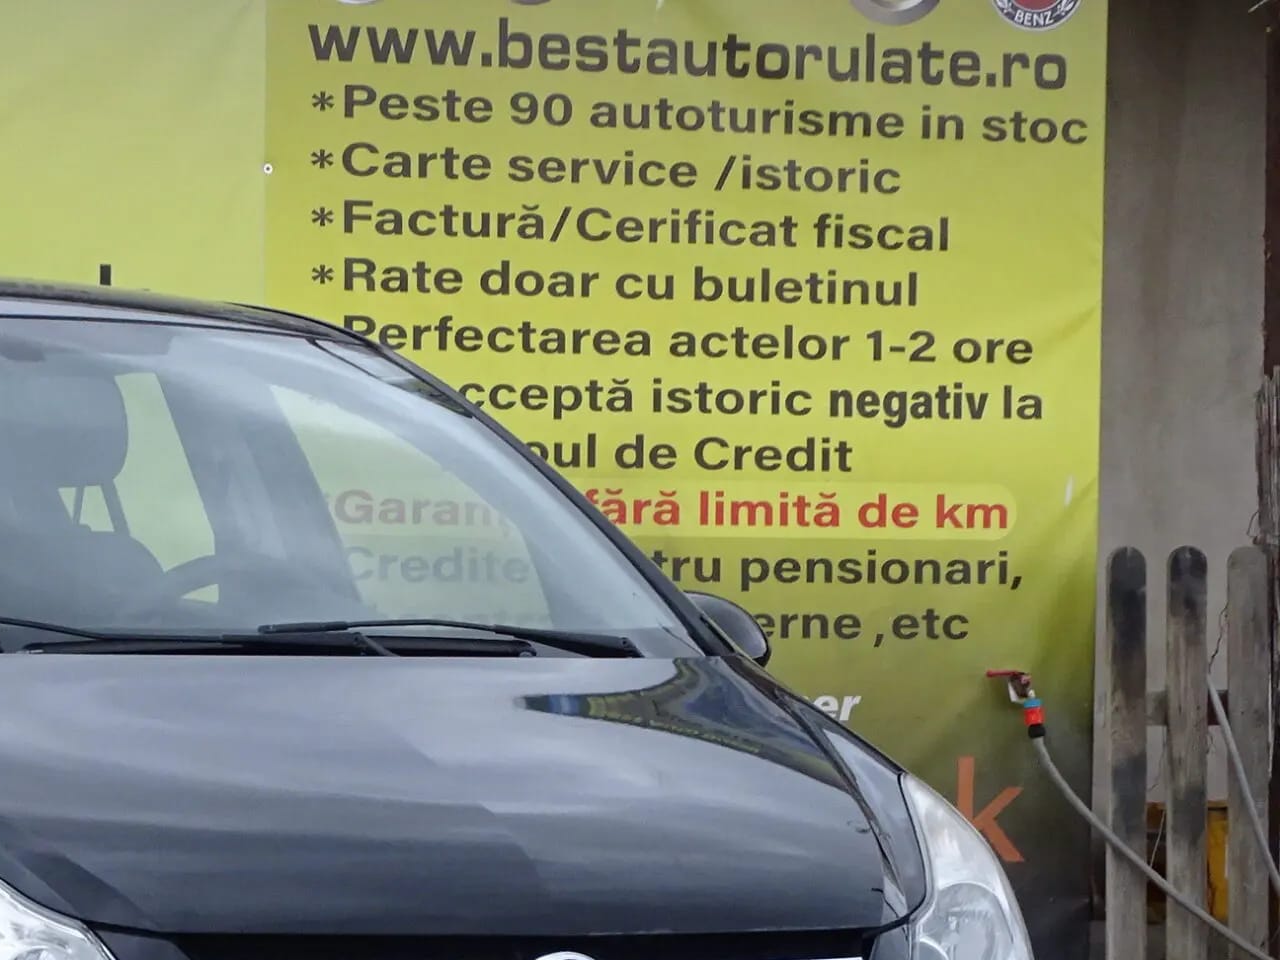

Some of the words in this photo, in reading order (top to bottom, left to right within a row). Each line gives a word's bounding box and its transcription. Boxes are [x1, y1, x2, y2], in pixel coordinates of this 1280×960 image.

[1014, 9, 1054, 27] BENZ
[308, 17, 1068, 90] www.bestautorulate.ro
[509, 92, 573, 126] 90
[590, 98, 904, 137] autoturisme
[921, 105, 964, 141] in
[981, 110, 1088, 146] stoc
[508, 150, 698, 187] service
[714, 155, 901, 195] /istoric
[813, 213, 949, 252] fiscal
[479, 261, 600, 298] doar
[615, 271, 674, 301] cu
[693, 267, 918, 306] buletinul
[344, 315, 651, 356] Perfectarea
[668, 325, 850, 361] actelor
[866, 331, 937, 363] 1-2
[952, 337, 1033, 365] ore
[458, 378, 633, 419] cceptă
[653, 376, 811, 416] istoric
[829, 382, 987, 426] negativ
[1002, 387, 1043, 420] la
[524, 431, 596, 468] oul
[615, 434, 676, 470] de
[694, 437, 853, 472] Credit
[698, 490, 838, 528] limită
[858, 494, 920, 529] de
[936, 497, 1008, 530] km
[651, 550, 721, 583] tru
[741, 550, 1022, 591] pensionari,
[757, 613, 862, 640] erne
